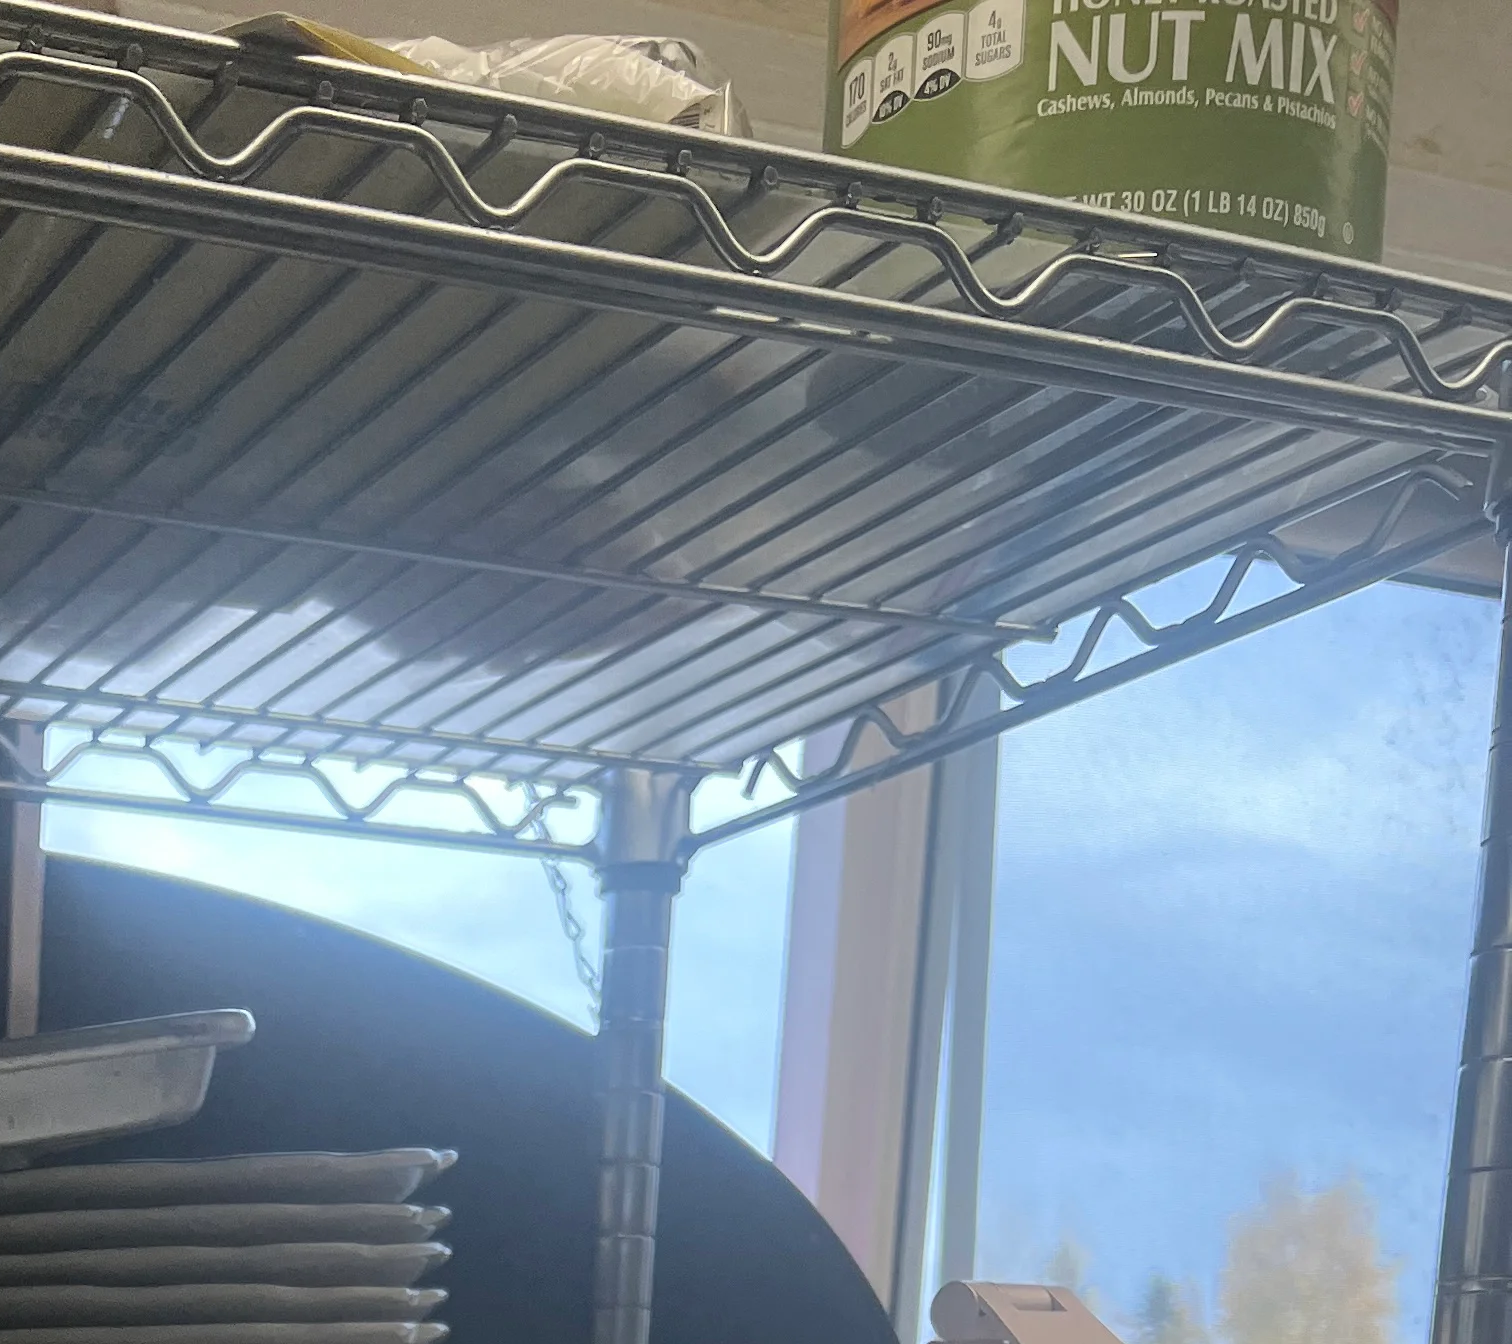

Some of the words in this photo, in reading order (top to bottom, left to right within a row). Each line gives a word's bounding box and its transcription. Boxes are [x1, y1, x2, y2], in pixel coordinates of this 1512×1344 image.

[975, 45, 1012, 66] SUGARS
[981, 30, 1006, 48] TOTAL
[1048, 10, 1206, 92] NUT
[1226, 13, 1337, 104] MIX
[923, 46, 955, 70] SODIUM
[849, 72, 865, 108] 170
[1037, 90, 1116, 117] Cashews,
[1121, 86, 1199, 108] Almonds,
[1206, 88, 1258, 109] Pecans
[1263, 95, 1273, 112] &
[1277, 98, 1336, 129] Pistachios
[1120, 191, 1145, 212] 30
[1151, 190, 1177, 212] OZ
[1184, 189, 1200, 217] (1
[1208, 191, 1230, 214] LB
[1238, 193, 1256, 217] 14
[1262, 197, 1289, 227] OZ)
[1294, 208, 1326, 238] 850g
